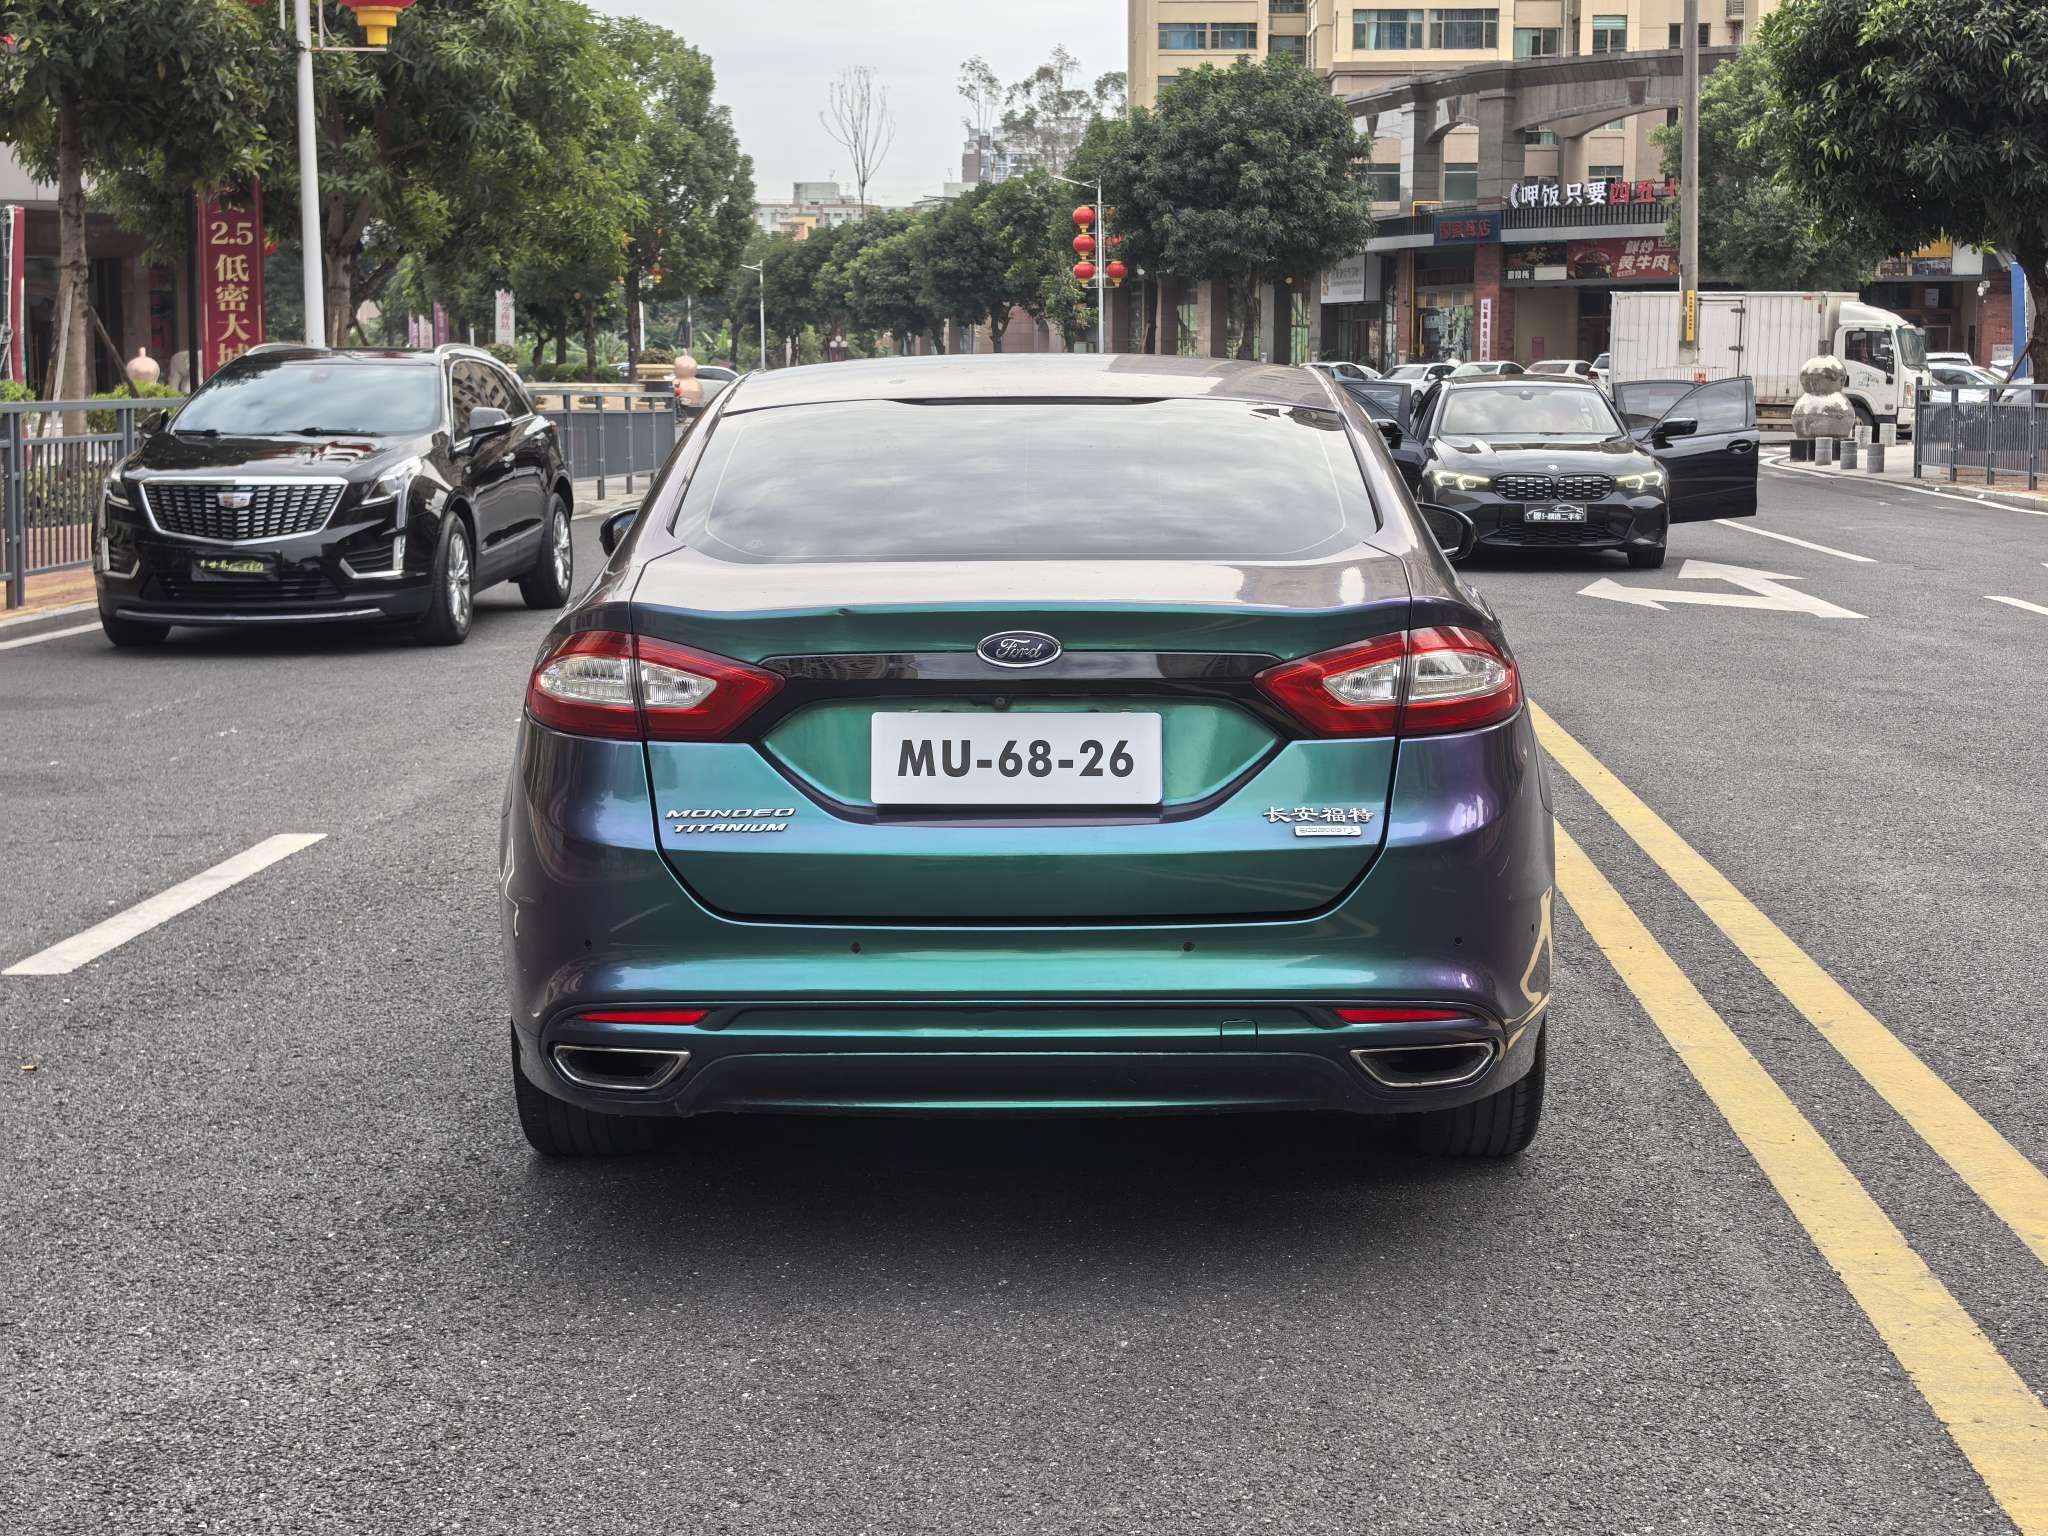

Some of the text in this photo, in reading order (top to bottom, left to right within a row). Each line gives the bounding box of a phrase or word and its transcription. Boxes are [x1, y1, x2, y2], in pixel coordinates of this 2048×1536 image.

[210, 221, 254, 245] 2.5
[1617, 254, 1671, 273] 黄牛肉
[996, 637, 1042, 660] Ford
[897, 739, 1134, 778] MU-68-26
[665, 807, 796, 820] MONDEO
[1263, 805, 1376, 824] 长安福特
[674, 822, 788, 834] TITANIUM
